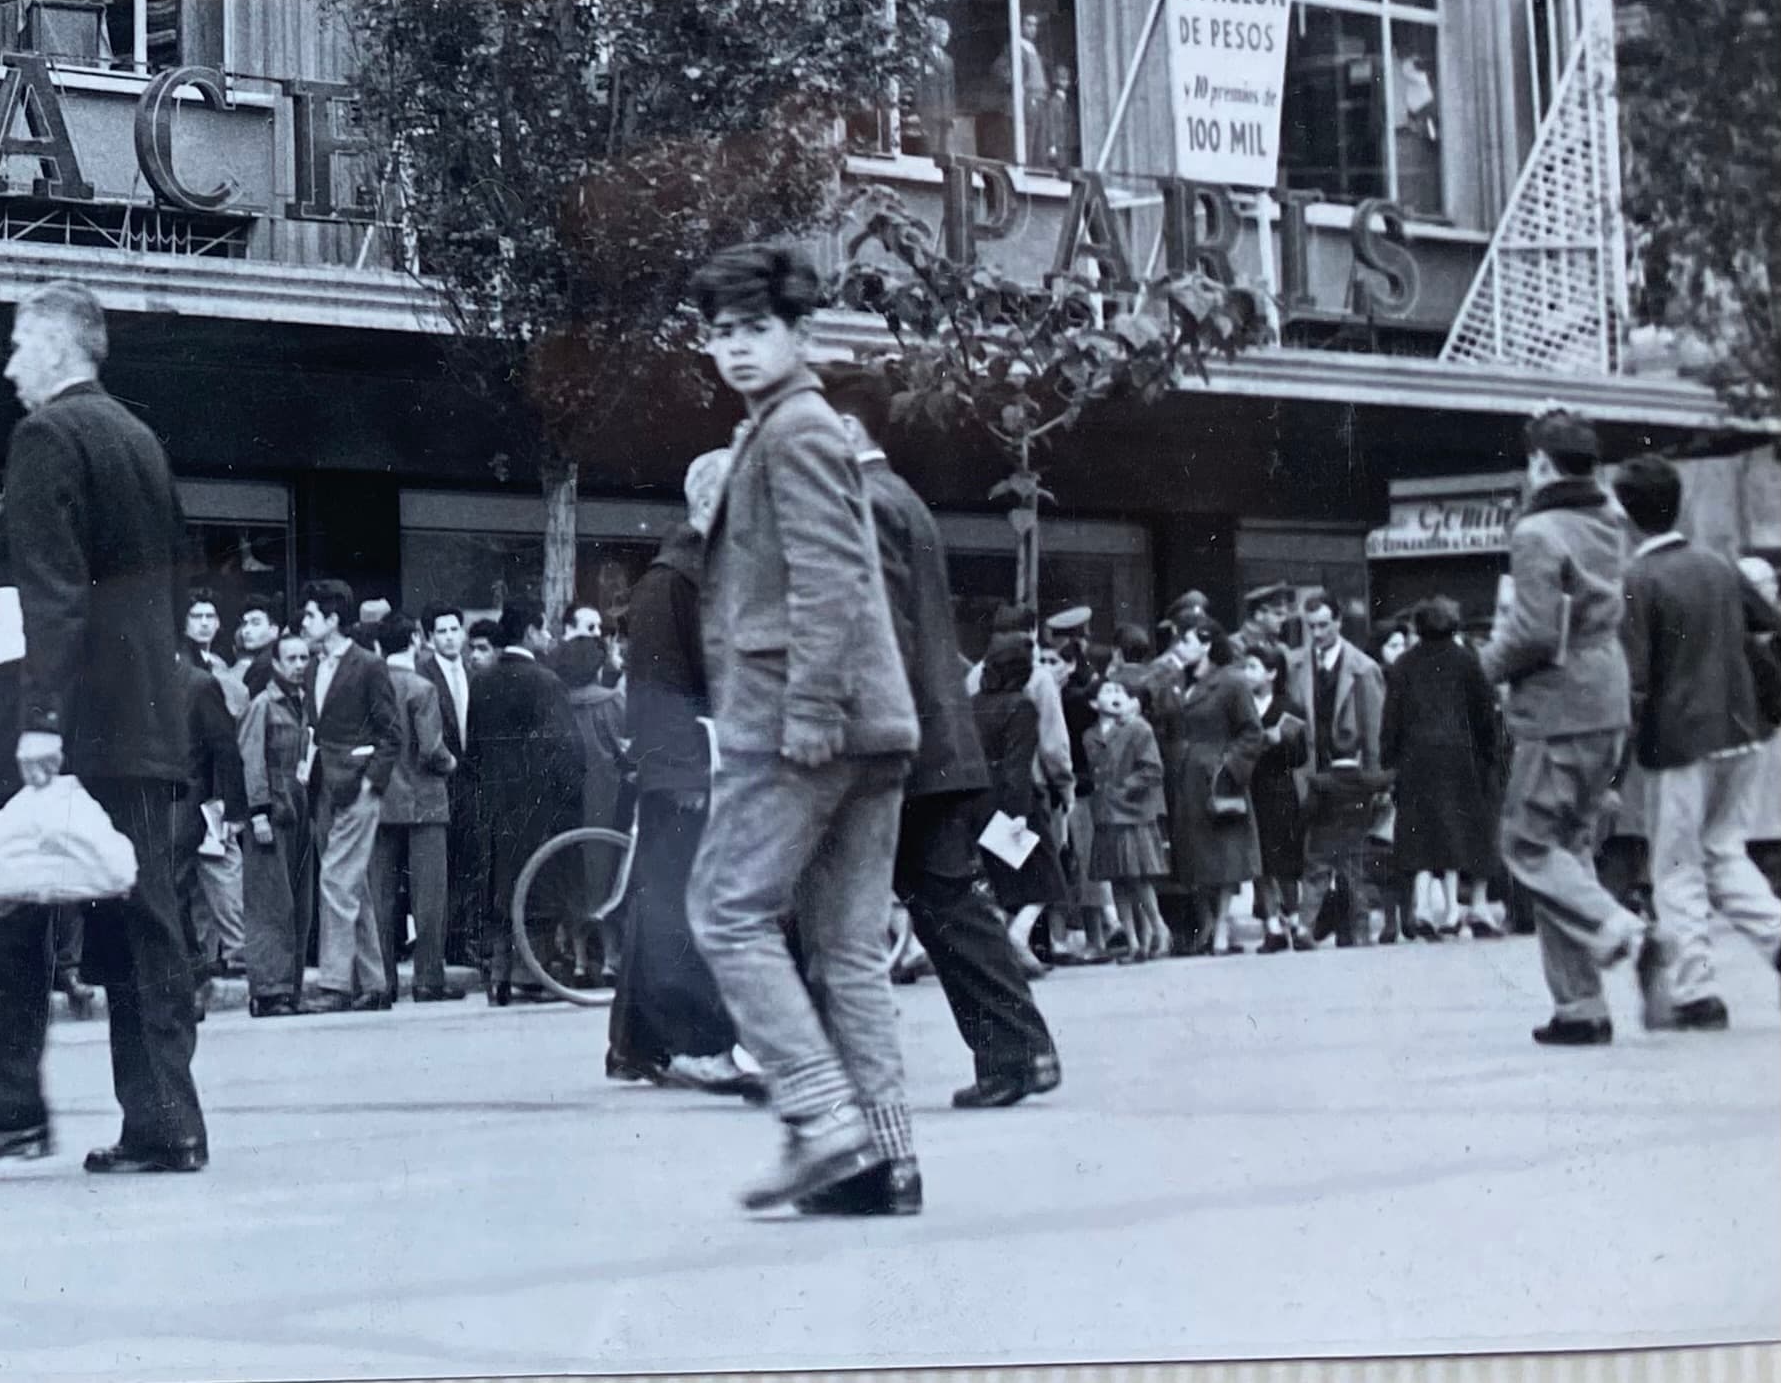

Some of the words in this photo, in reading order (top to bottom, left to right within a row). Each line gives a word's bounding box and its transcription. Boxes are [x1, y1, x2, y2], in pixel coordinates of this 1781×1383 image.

[1179, 17, 1204, 45] DE
[1210, 23, 1274, 52] PESOS
[1194, 75, 1208, 99] 10
[1188, 115, 1221, 153] 100
[1230, 122, 1267, 157] MIL
[932, 153, 1420, 317] PARIS
